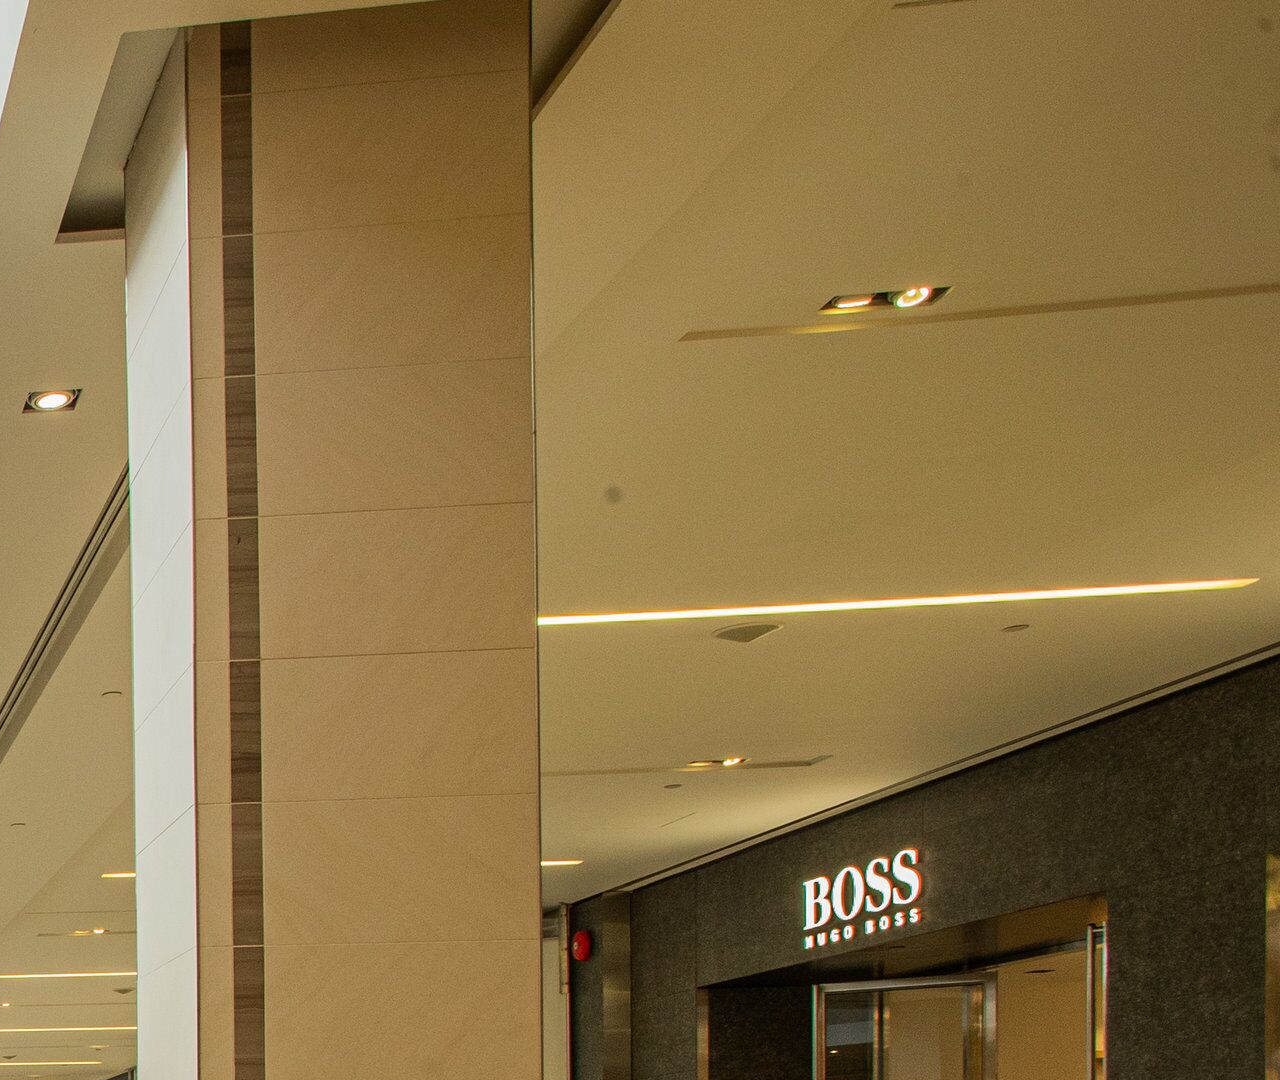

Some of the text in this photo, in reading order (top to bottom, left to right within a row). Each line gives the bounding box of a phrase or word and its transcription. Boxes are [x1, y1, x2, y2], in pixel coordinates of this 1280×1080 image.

[802, 848, 922, 931] BOSS
[804, 907, 922, 950] HUGO BOSS
